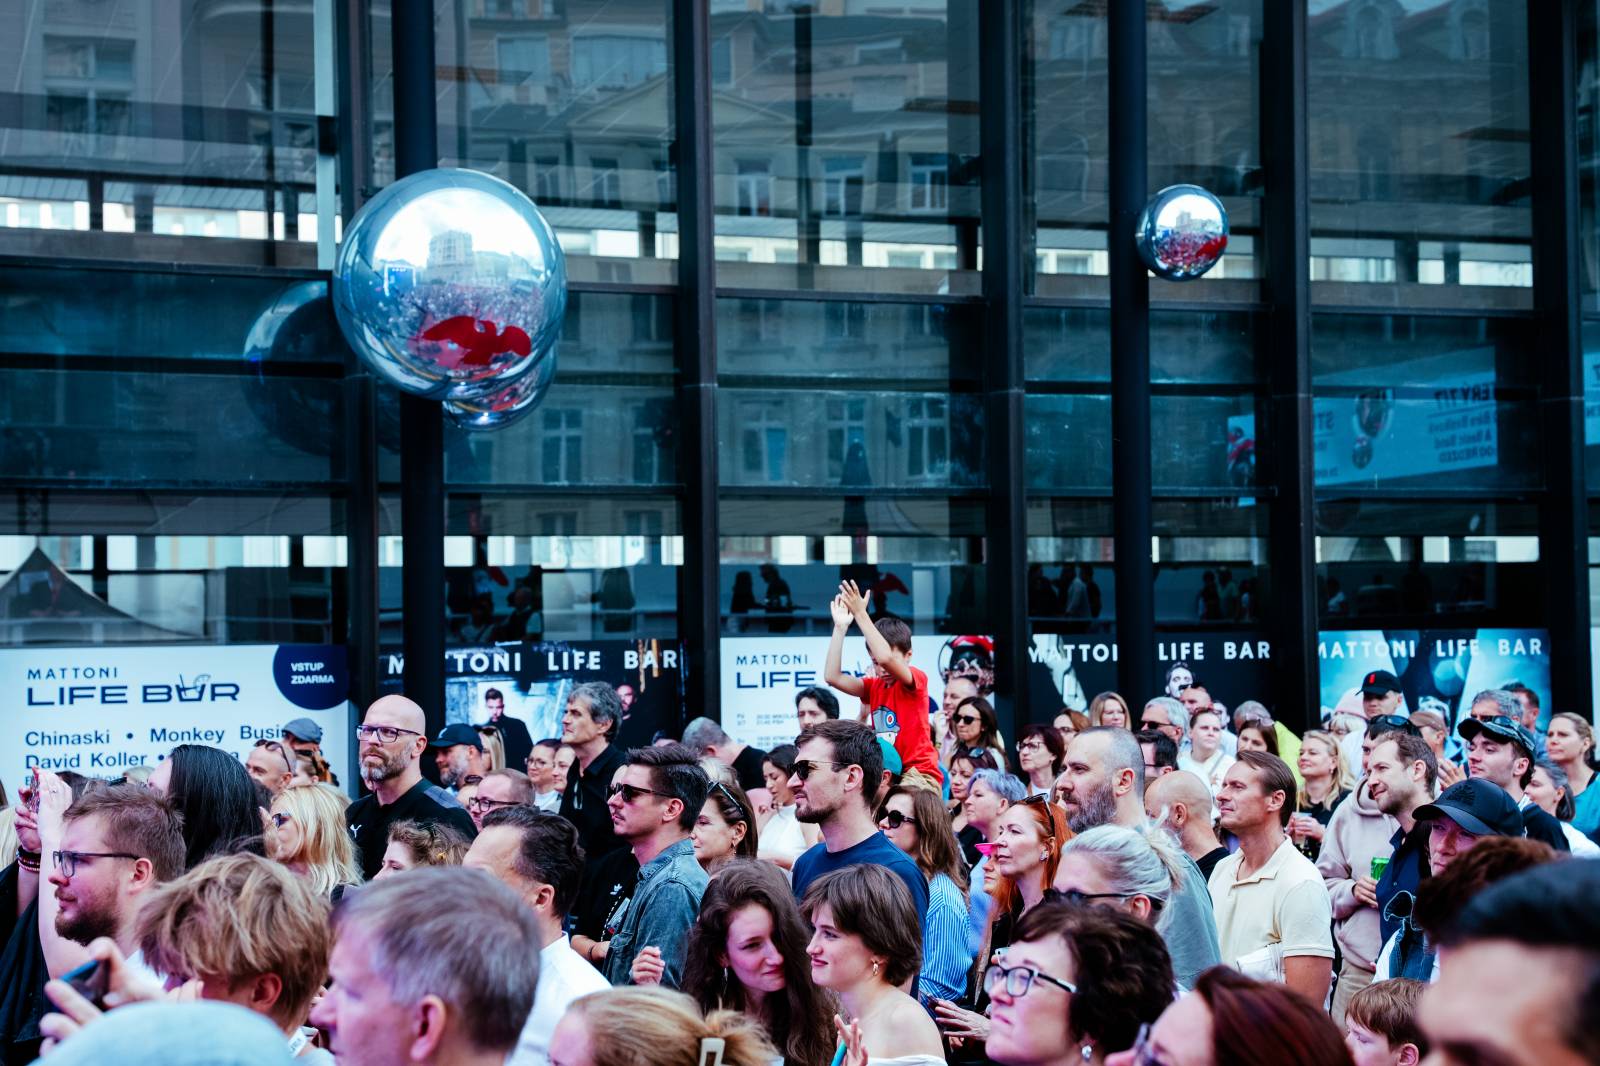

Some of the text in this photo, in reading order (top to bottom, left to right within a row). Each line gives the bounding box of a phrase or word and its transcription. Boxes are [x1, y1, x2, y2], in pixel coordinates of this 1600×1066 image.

[1159, 642, 1204, 661] LIFE
[1224, 641, 1271, 660] BAR
[1436, 639, 1480, 658] LIFE
[1498, 638, 1542, 657] BAR
[291, 662, 325, 672] VSTUP
[388, 650, 677, 675] MTONI LIFE BAR
[736, 655, 808, 665] MATTONI
[27, 667, 117, 680] MATTONI
[291, 674, 335, 685] ZDARMA
[736, 671, 817, 689] LIFE
[27, 686, 128, 706] LIFE
[25, 729, 110, 747] Chinaski
[150, 727, 225, 744] Monkey
[25, 752, 148, 770] David Koller
